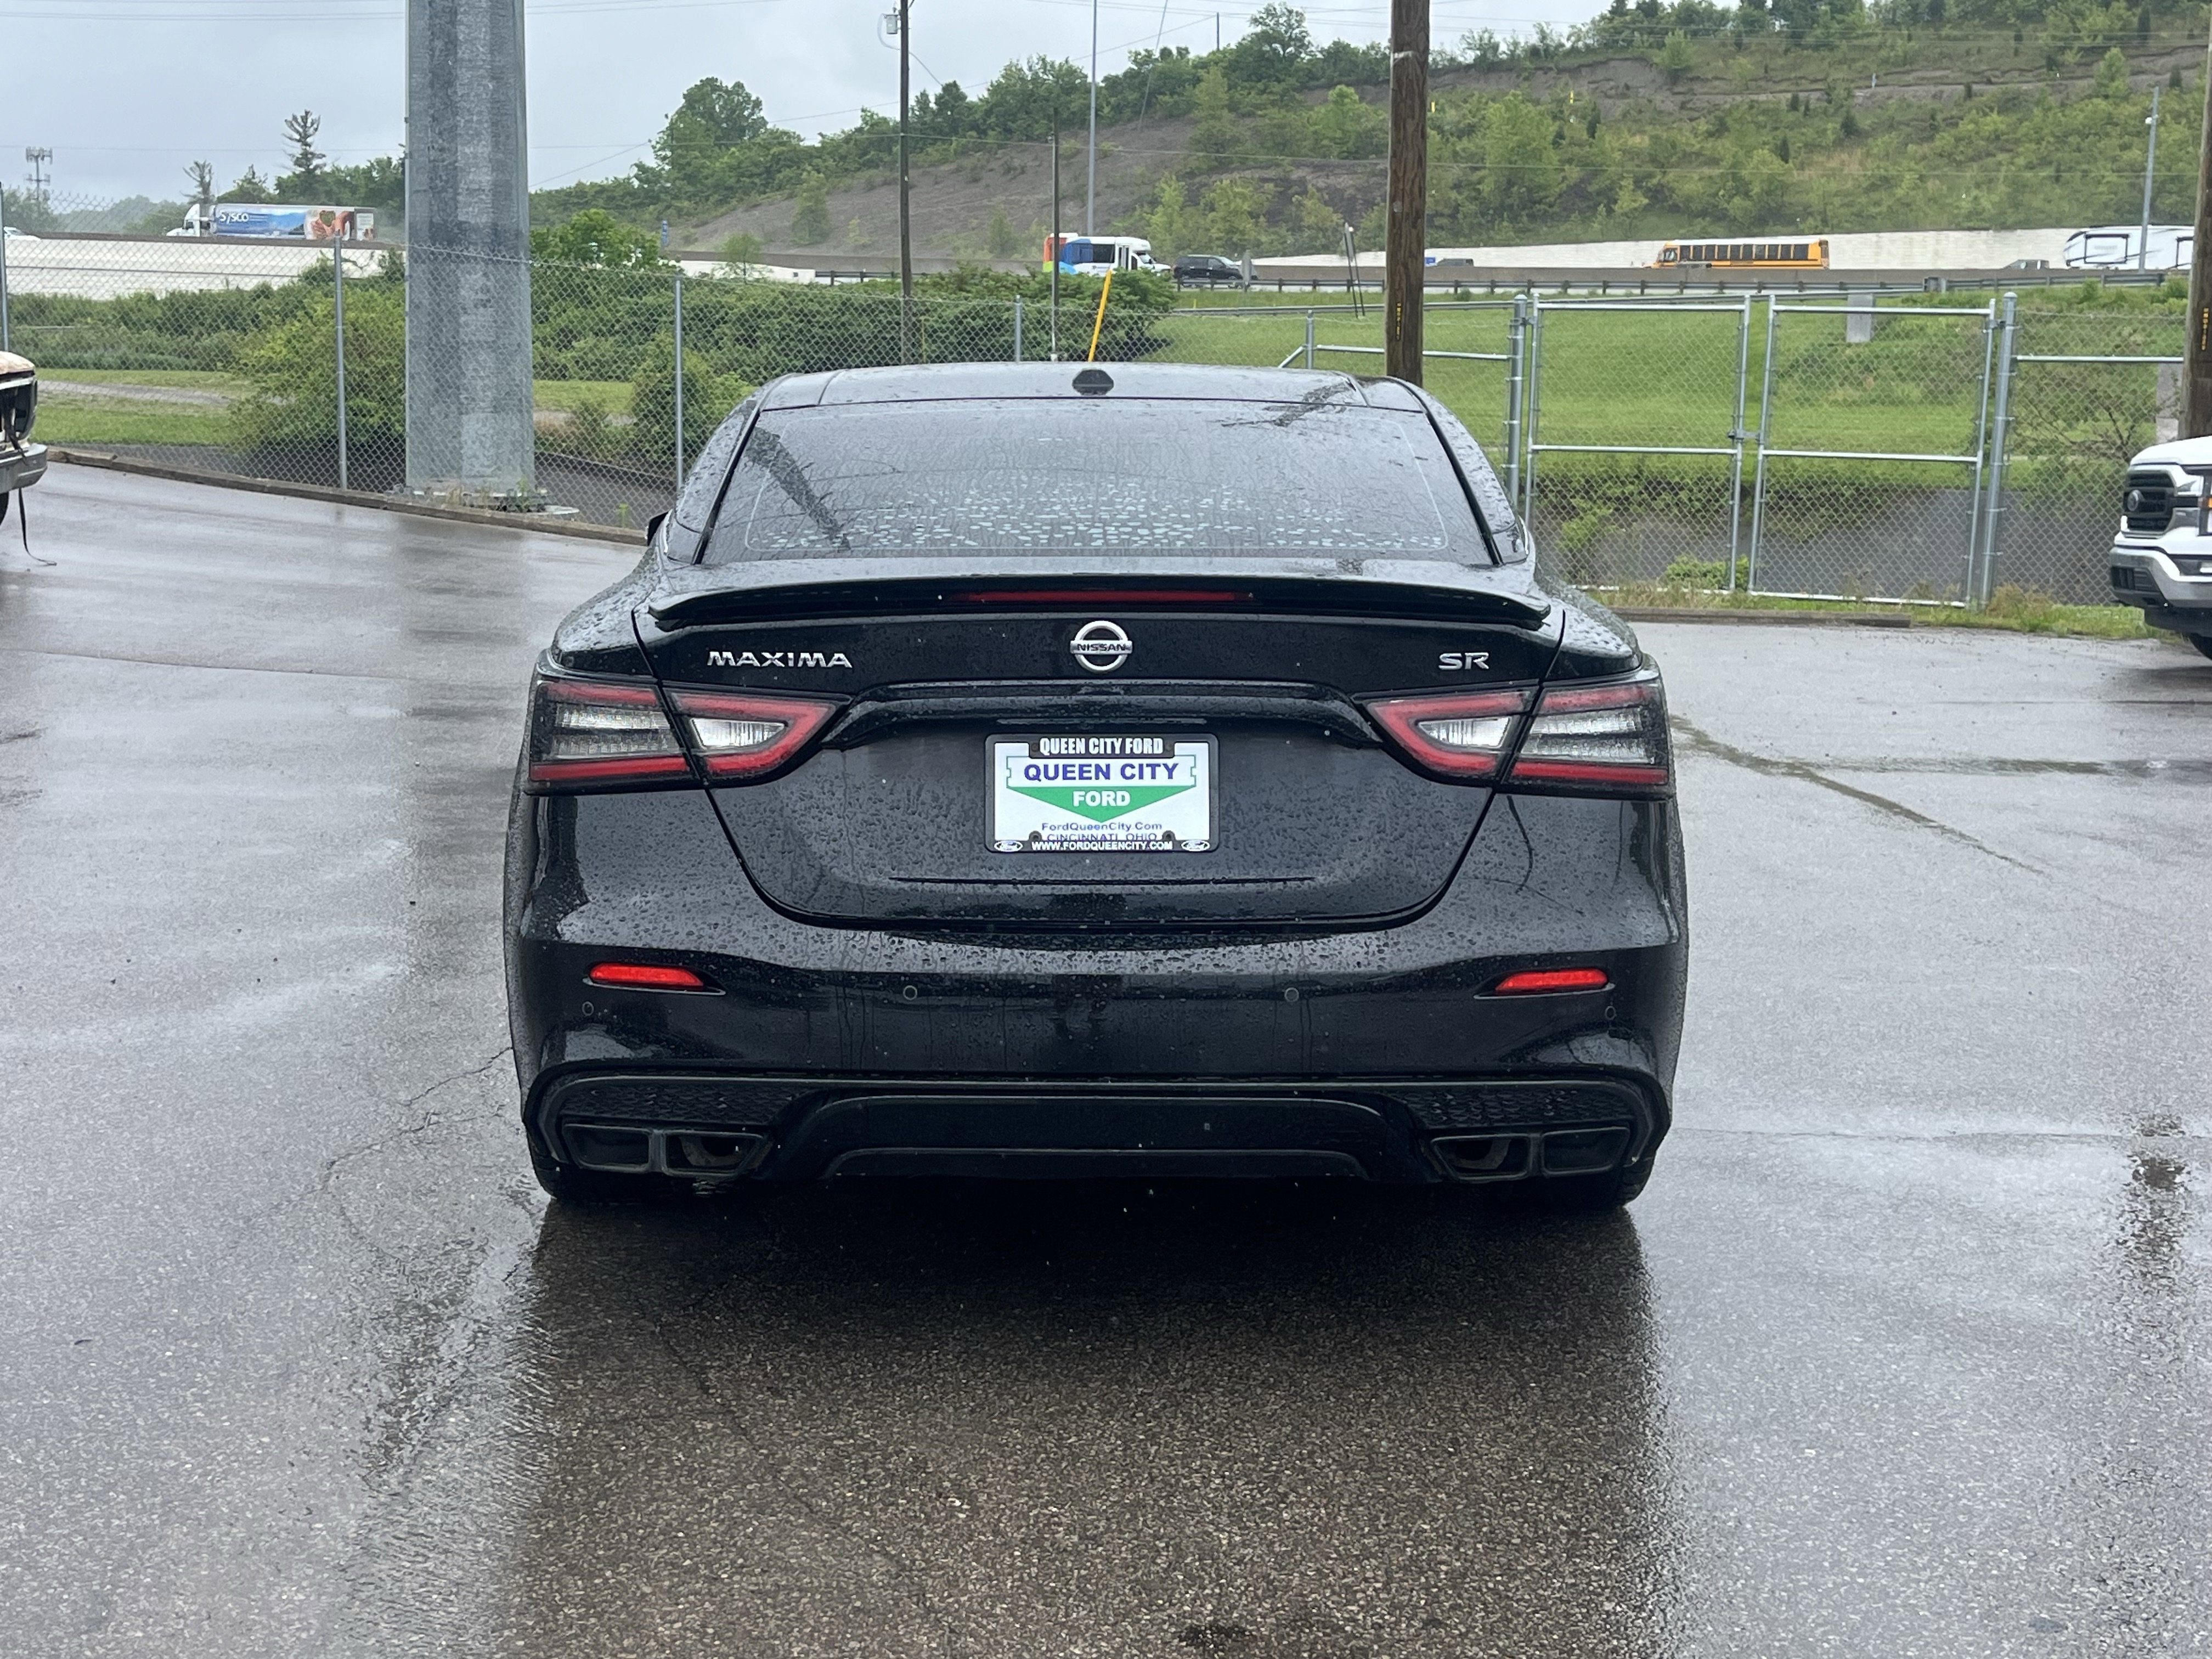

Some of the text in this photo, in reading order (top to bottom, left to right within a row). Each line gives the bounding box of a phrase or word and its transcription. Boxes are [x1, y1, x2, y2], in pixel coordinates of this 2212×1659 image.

[707, 651, 853, 668] MAXIMA
[1438, 652, 1489, 670] SR
[1040, 738, 1164, 755] QUEEN CITY FORD
[1024, 763, 1179, 782] QUEEN CITY
[1073, 790, 1131, 807] FORD
[1031, 840, 1173, 851] WWW.FORDQUEENCITY.COM
